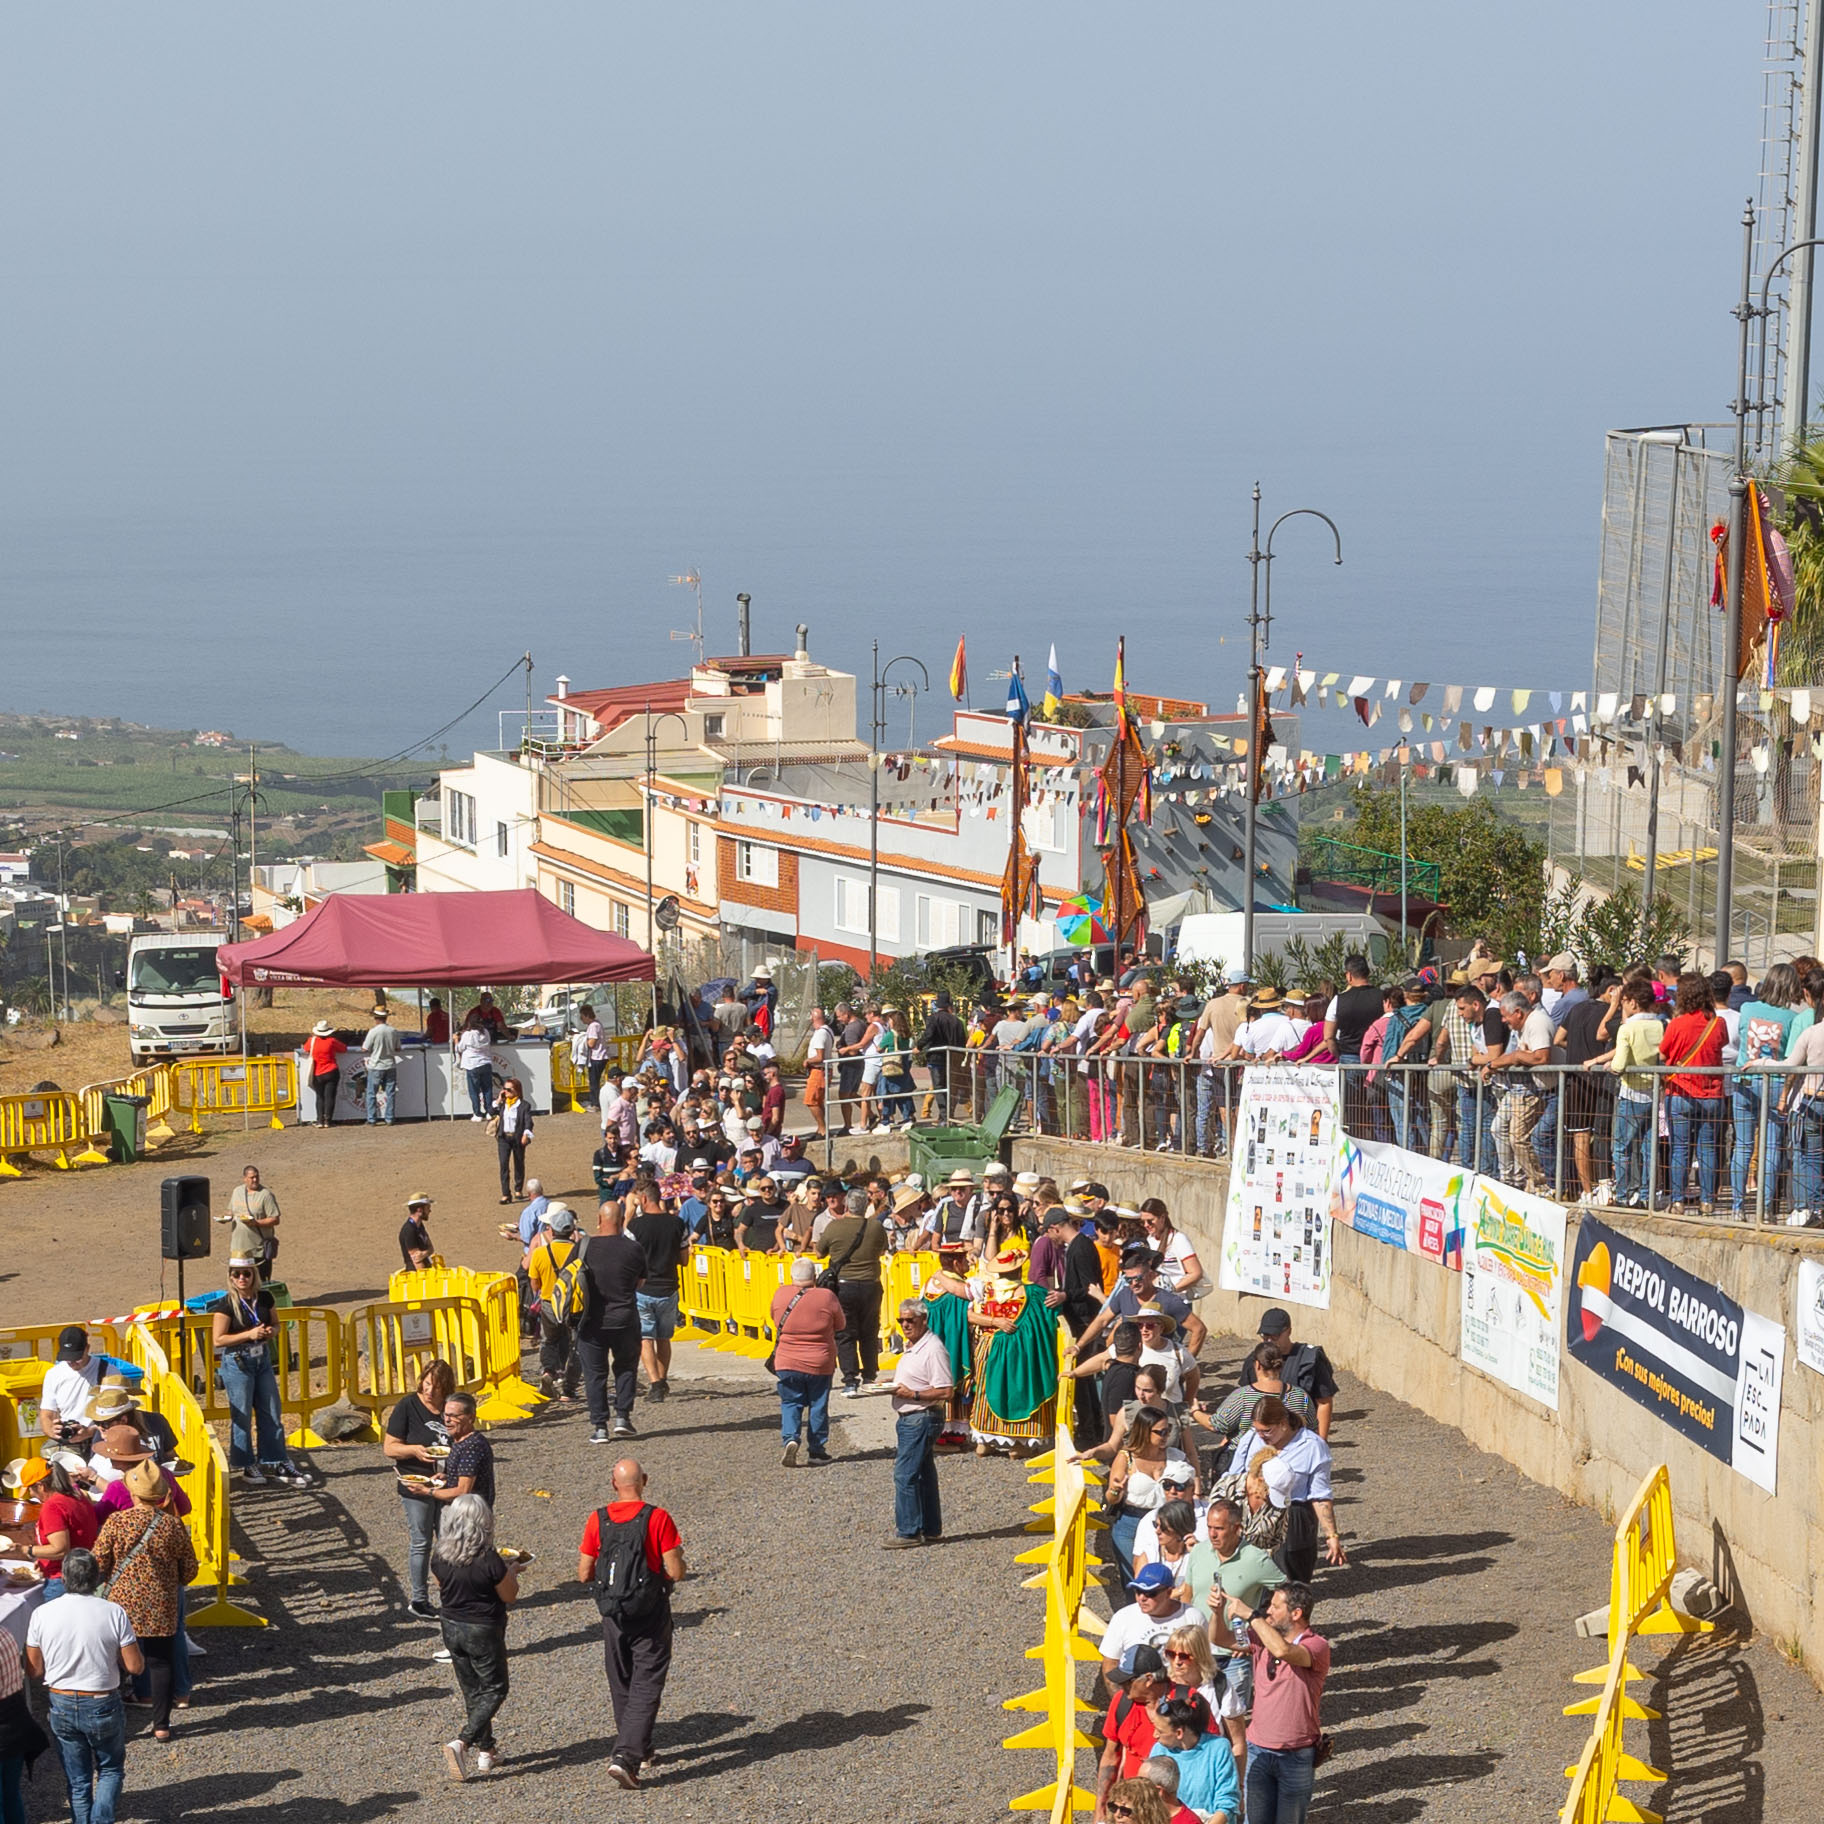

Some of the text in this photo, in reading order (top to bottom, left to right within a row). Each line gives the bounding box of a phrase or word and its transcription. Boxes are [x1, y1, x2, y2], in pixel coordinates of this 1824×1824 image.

[1613, 1252, 1666, 1314] REPSOL
[1667, 1286, 1738, 1357] BARROSO
[1633, 1362, 1648, 1385] sus
[1648, 1371, 1680, 1404] mejores
[1679, 1393, 1715, 1430] precios!
